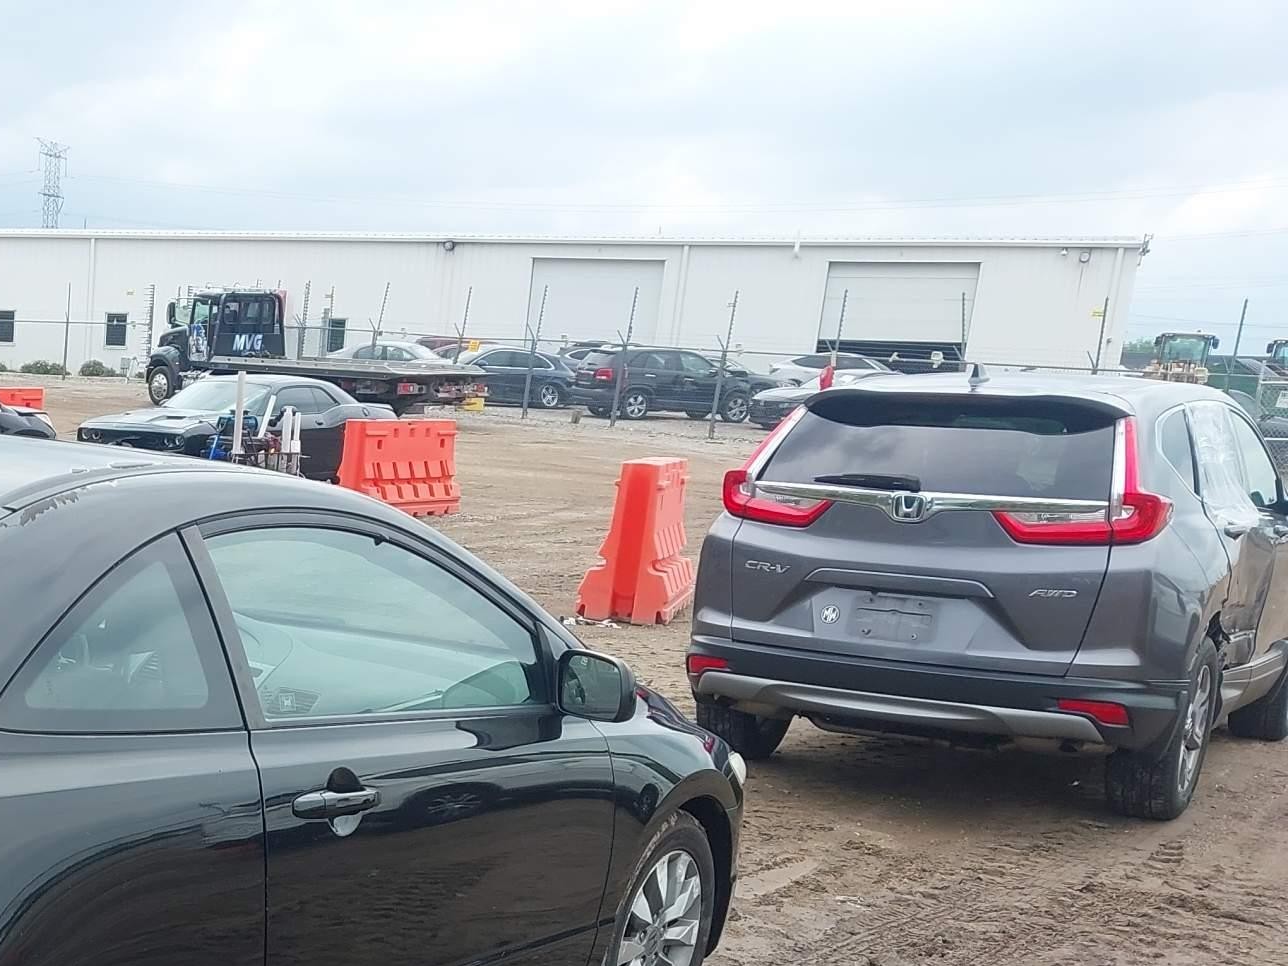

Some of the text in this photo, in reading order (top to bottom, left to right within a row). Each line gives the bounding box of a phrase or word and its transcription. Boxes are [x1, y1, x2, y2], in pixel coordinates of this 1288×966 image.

[232, 334, 264, 351] MVG
[744, 560, 791, 575] CR-V
[1028, 588, 1078, 599] AWD
